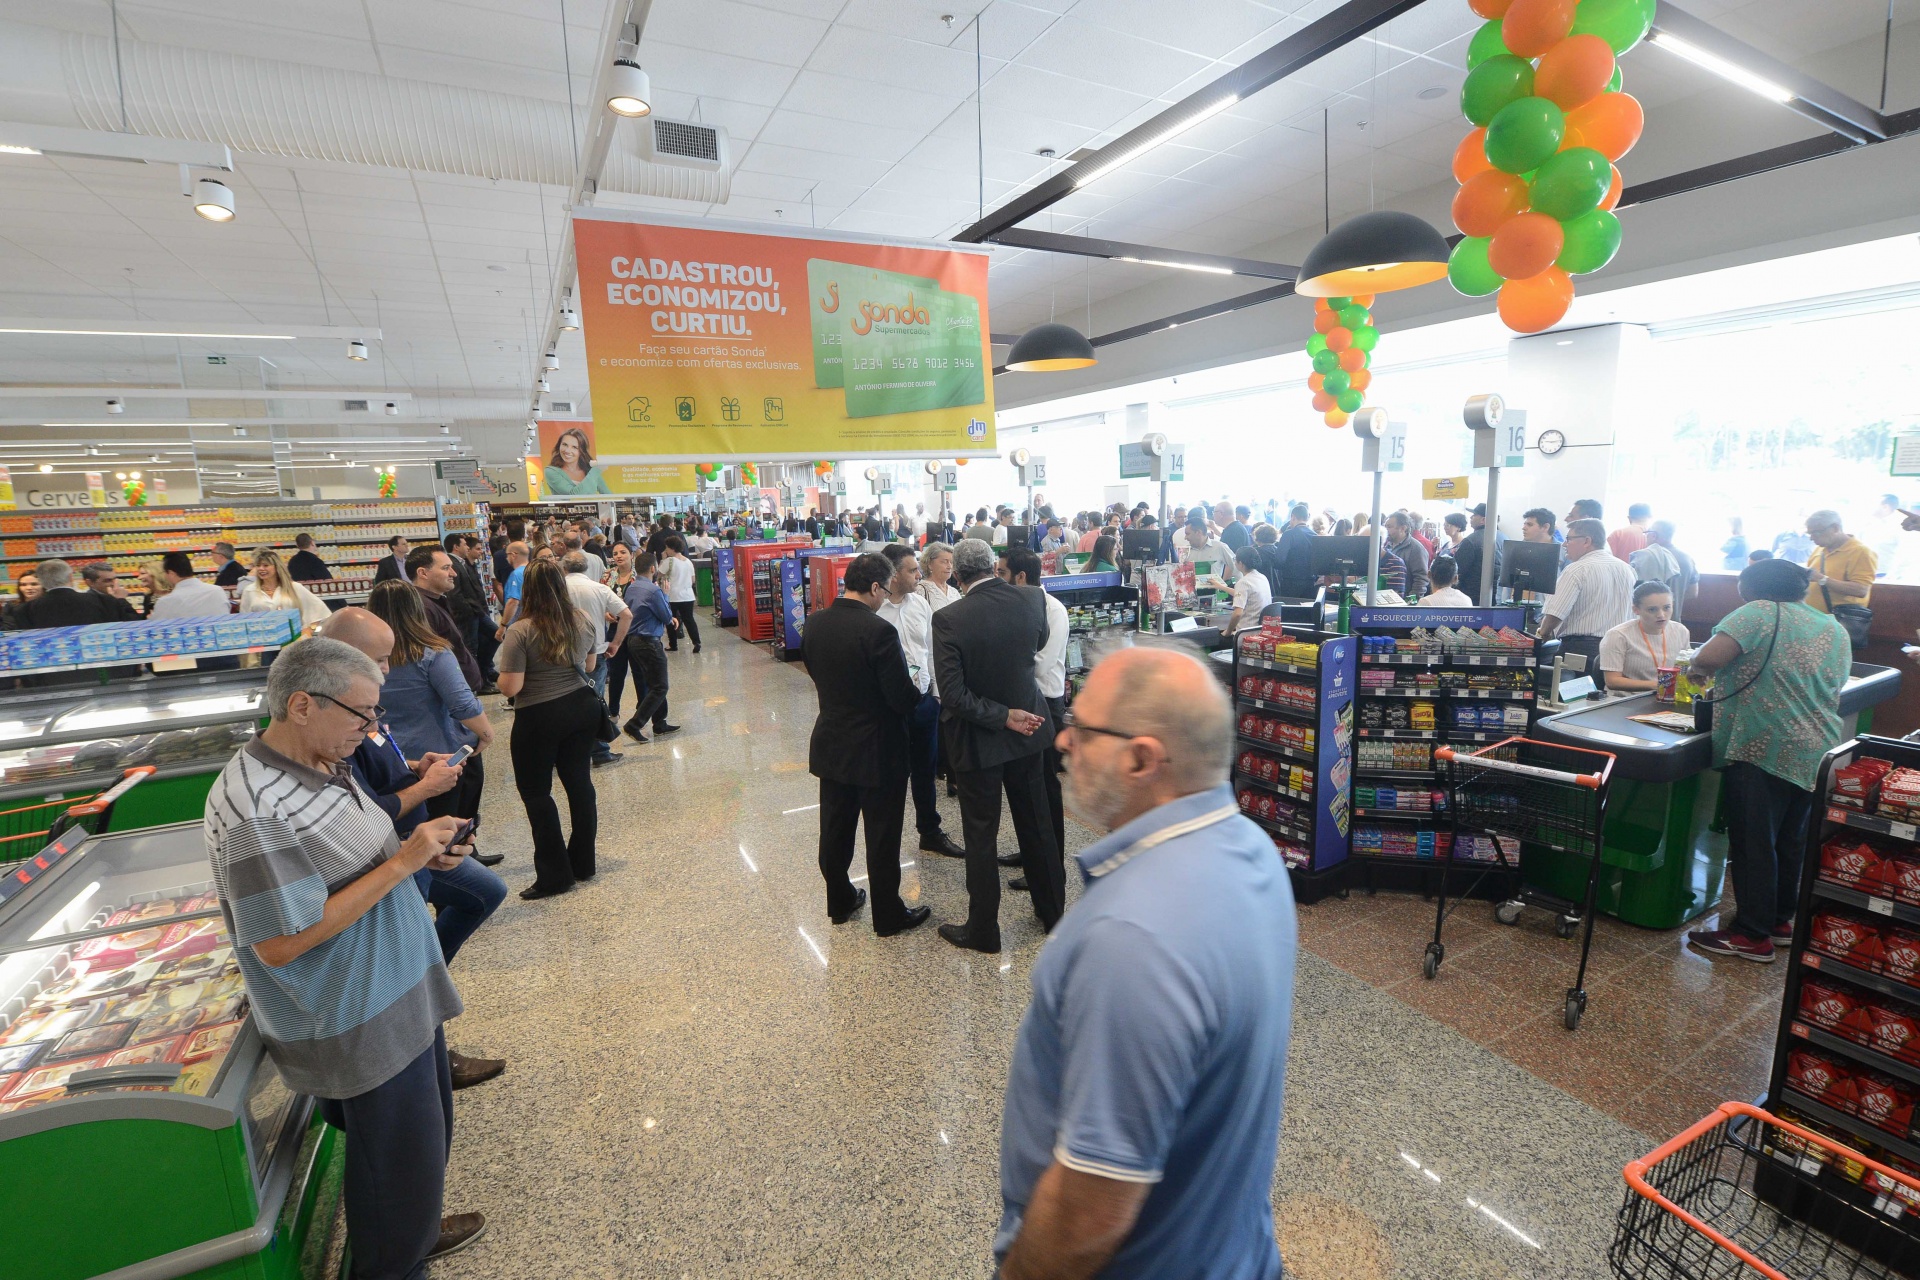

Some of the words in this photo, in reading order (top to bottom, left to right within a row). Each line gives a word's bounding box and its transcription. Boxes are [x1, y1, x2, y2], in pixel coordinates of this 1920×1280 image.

[611, 256, 779, 290] CADASTROU,
[606, 283, 787, 315] ECONOMIZOU,
[651, 311, 752, 335] CURTIU.
[874, 325, 930, 336] Supermercados
[639, 343, 666, 357] Faça
[669, 346, 691, 355] seu
[693, 345, 728, 356] cartão
[600, 359, 607, 367] e
[610, 358, 673, 368] economize
[676, 359, 701, 368] com
[703, 358, 743, 369] ofertas
[745, 359, 801, 370] exclusivas.
[852, 358, 883, 370] 1234
[892, 358, 919, 369] 5678
[925, 358, 948, 369] 9012
[954, 358, 974, 368] 3456
[968, 418, 986, 435] dm
[1391, 436, 1405, 459] 15
[1508, 426, 1524, 452] 16
[1034, 464, 1046, 478] 13
[1171, 454, 1183, 471] 14
[836, 481, 846, 491] 10
[882, 478, 891, 489] 11
[945, 473, 956, 484] 12
[797, 484, 802, 494] 9
[1373, 614, 1422, 622] ESQUECEU?
[1425, 614, 1476, 623] APROVEITE.
[1834, 853, 1866, 875] KitKat
[1826, 928, 1857, 949] KitKat
[1814, 999, 1845, 1019] KitKat
[1874, 1023, 1909, 1044] KitKat
[1862, 1093, 1893, 1115] KitKat
